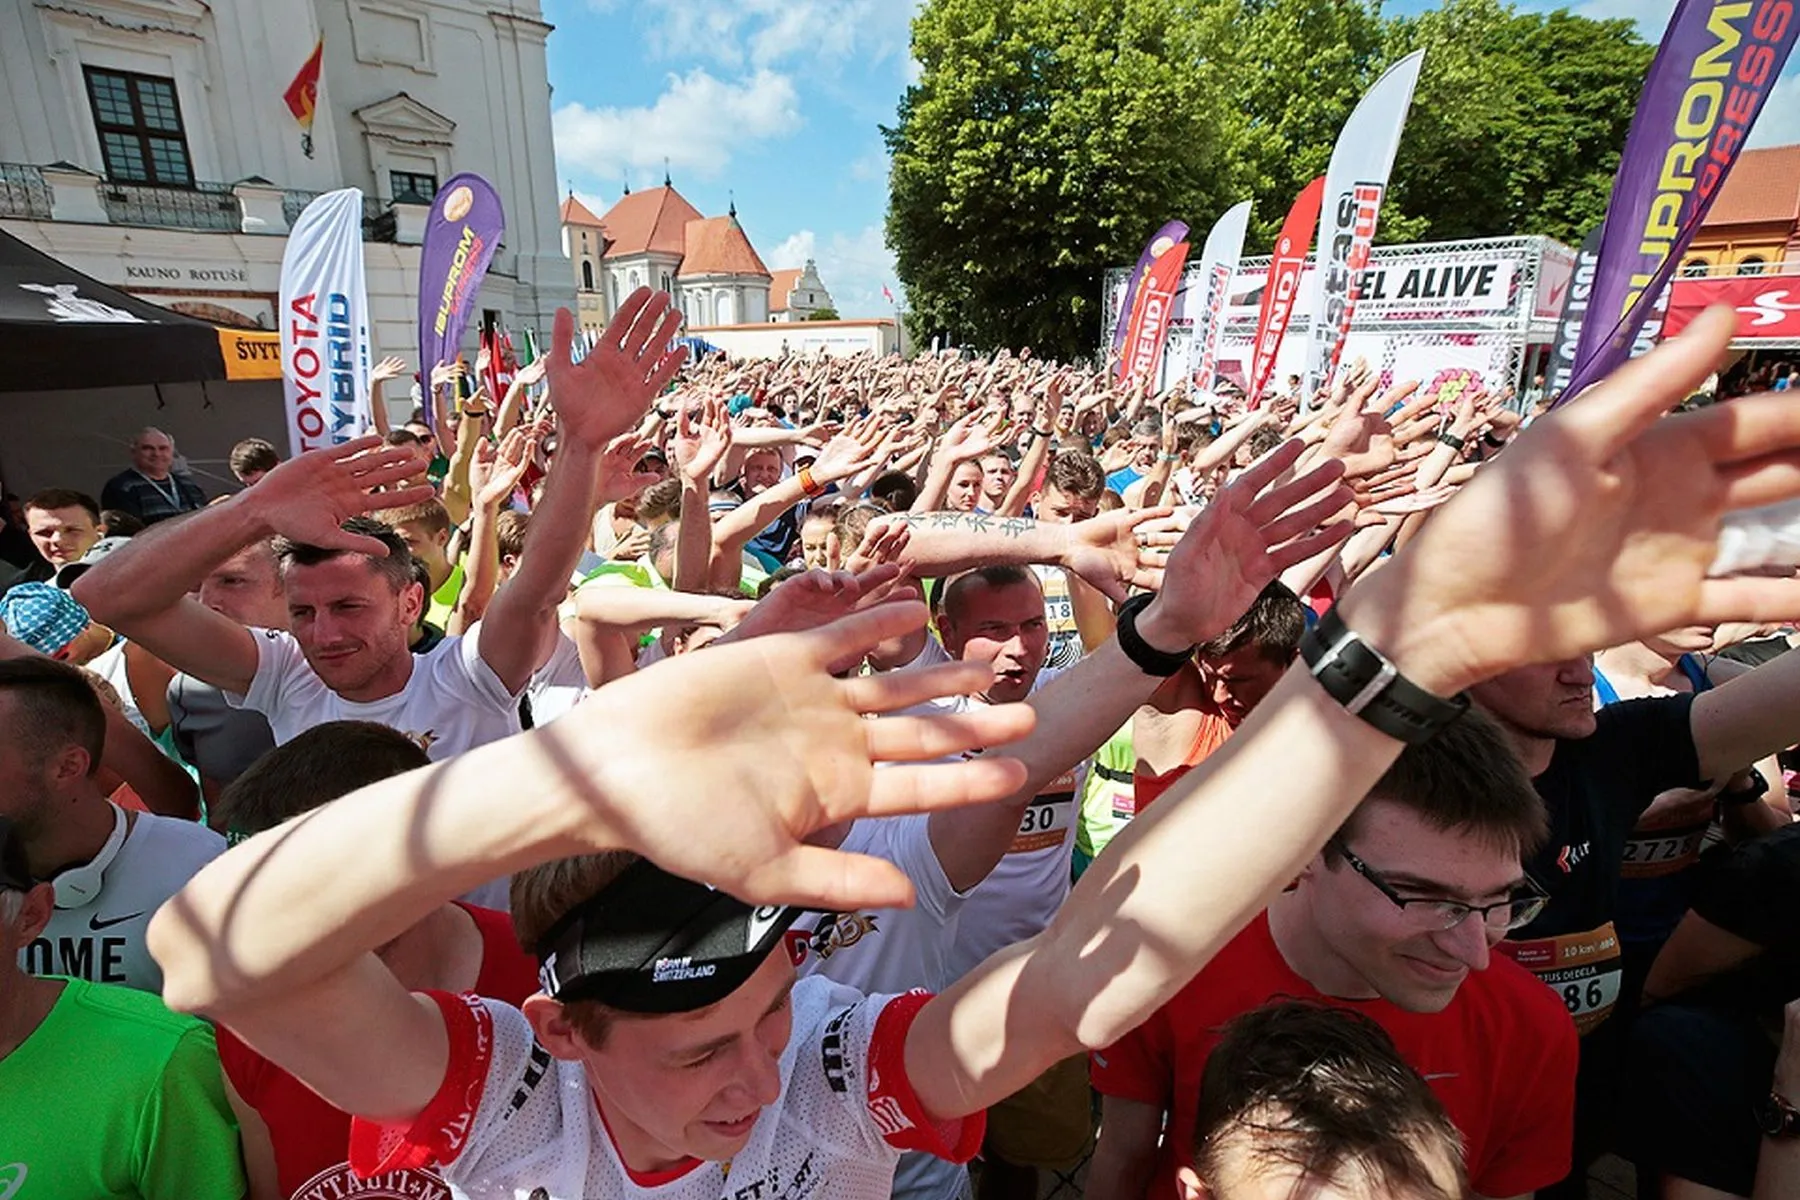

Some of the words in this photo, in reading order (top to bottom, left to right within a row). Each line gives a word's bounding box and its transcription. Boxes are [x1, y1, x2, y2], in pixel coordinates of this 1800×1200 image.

[126, 266, 181, 279] KAUNO
[434, 224, 475, 338] IBUPROM
[1396, 264, 1498, 299] ALIVE
[1132, 299, 1162, 376] REND
[1254, 270, 1295, 380] REND
[1019, 806, 1054, 832] 30
[1563, 979, 1603, 1013] 86
